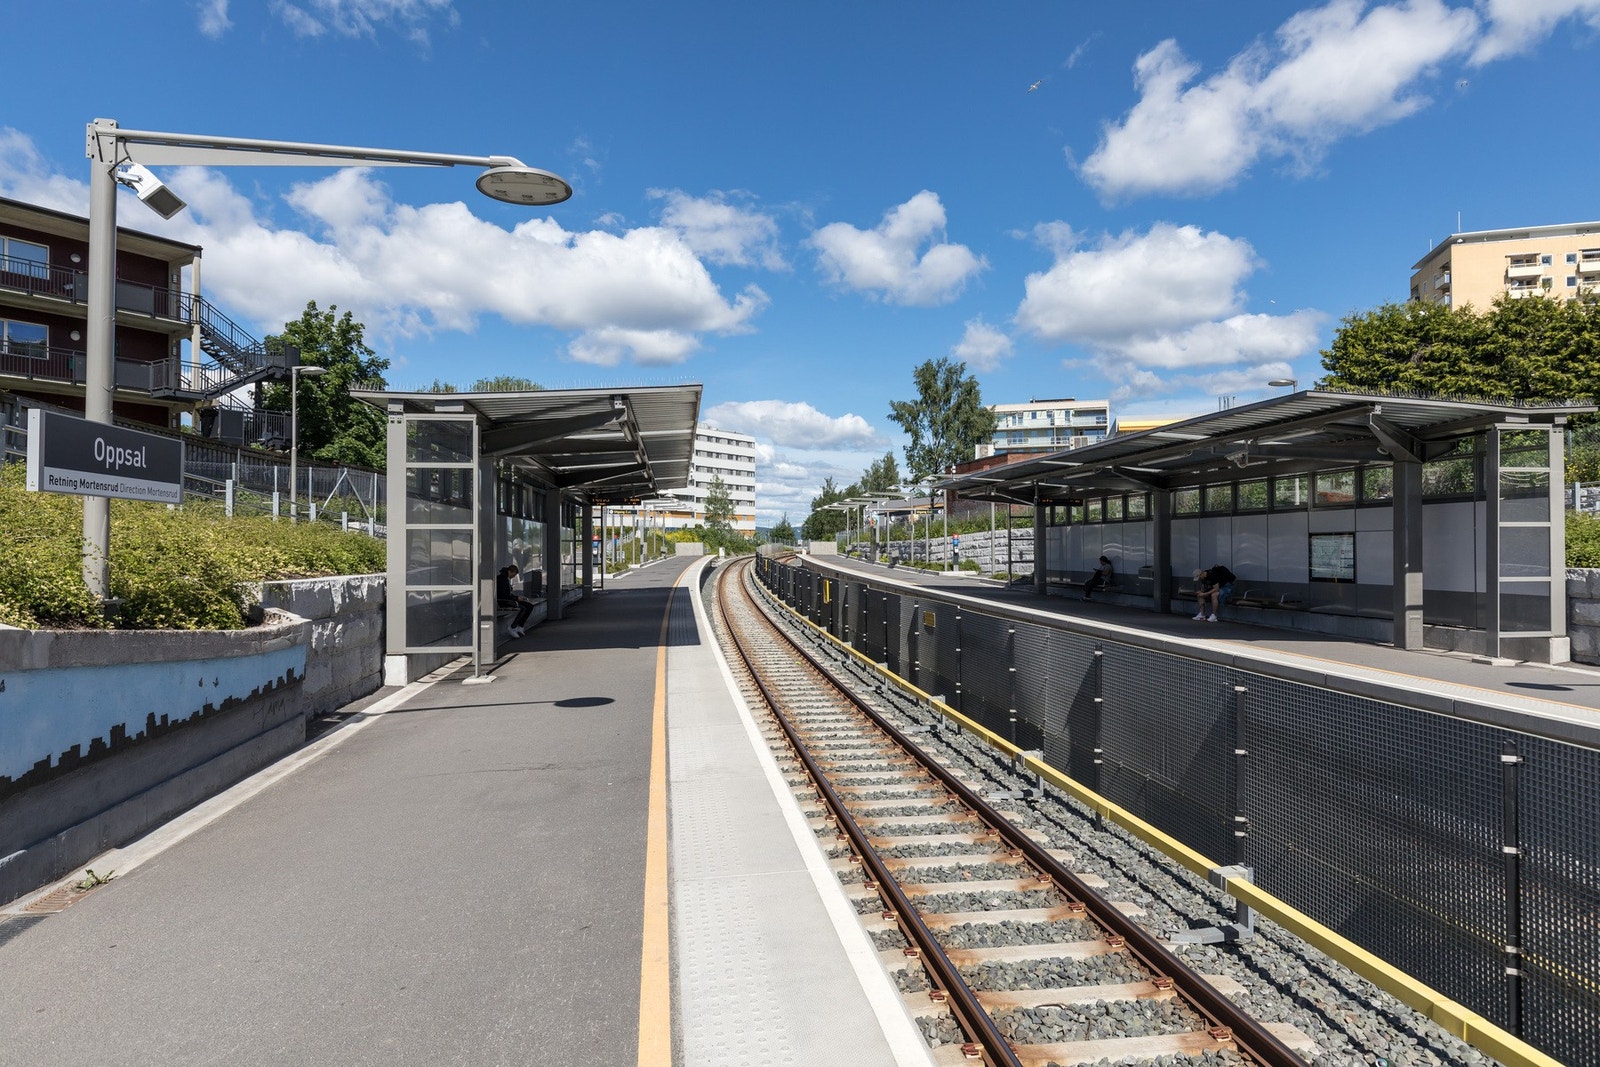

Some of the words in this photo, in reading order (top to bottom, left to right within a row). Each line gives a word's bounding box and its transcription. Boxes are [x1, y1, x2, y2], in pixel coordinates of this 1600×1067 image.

[94, 437, 147, 470] Oppsal
[49, 475, 78, 490] Retning
[79, 479, 118, 493] Mortensrud
[119, 483, 146, 495] Direction
[147, 485, 178, 499] Mortensrud
